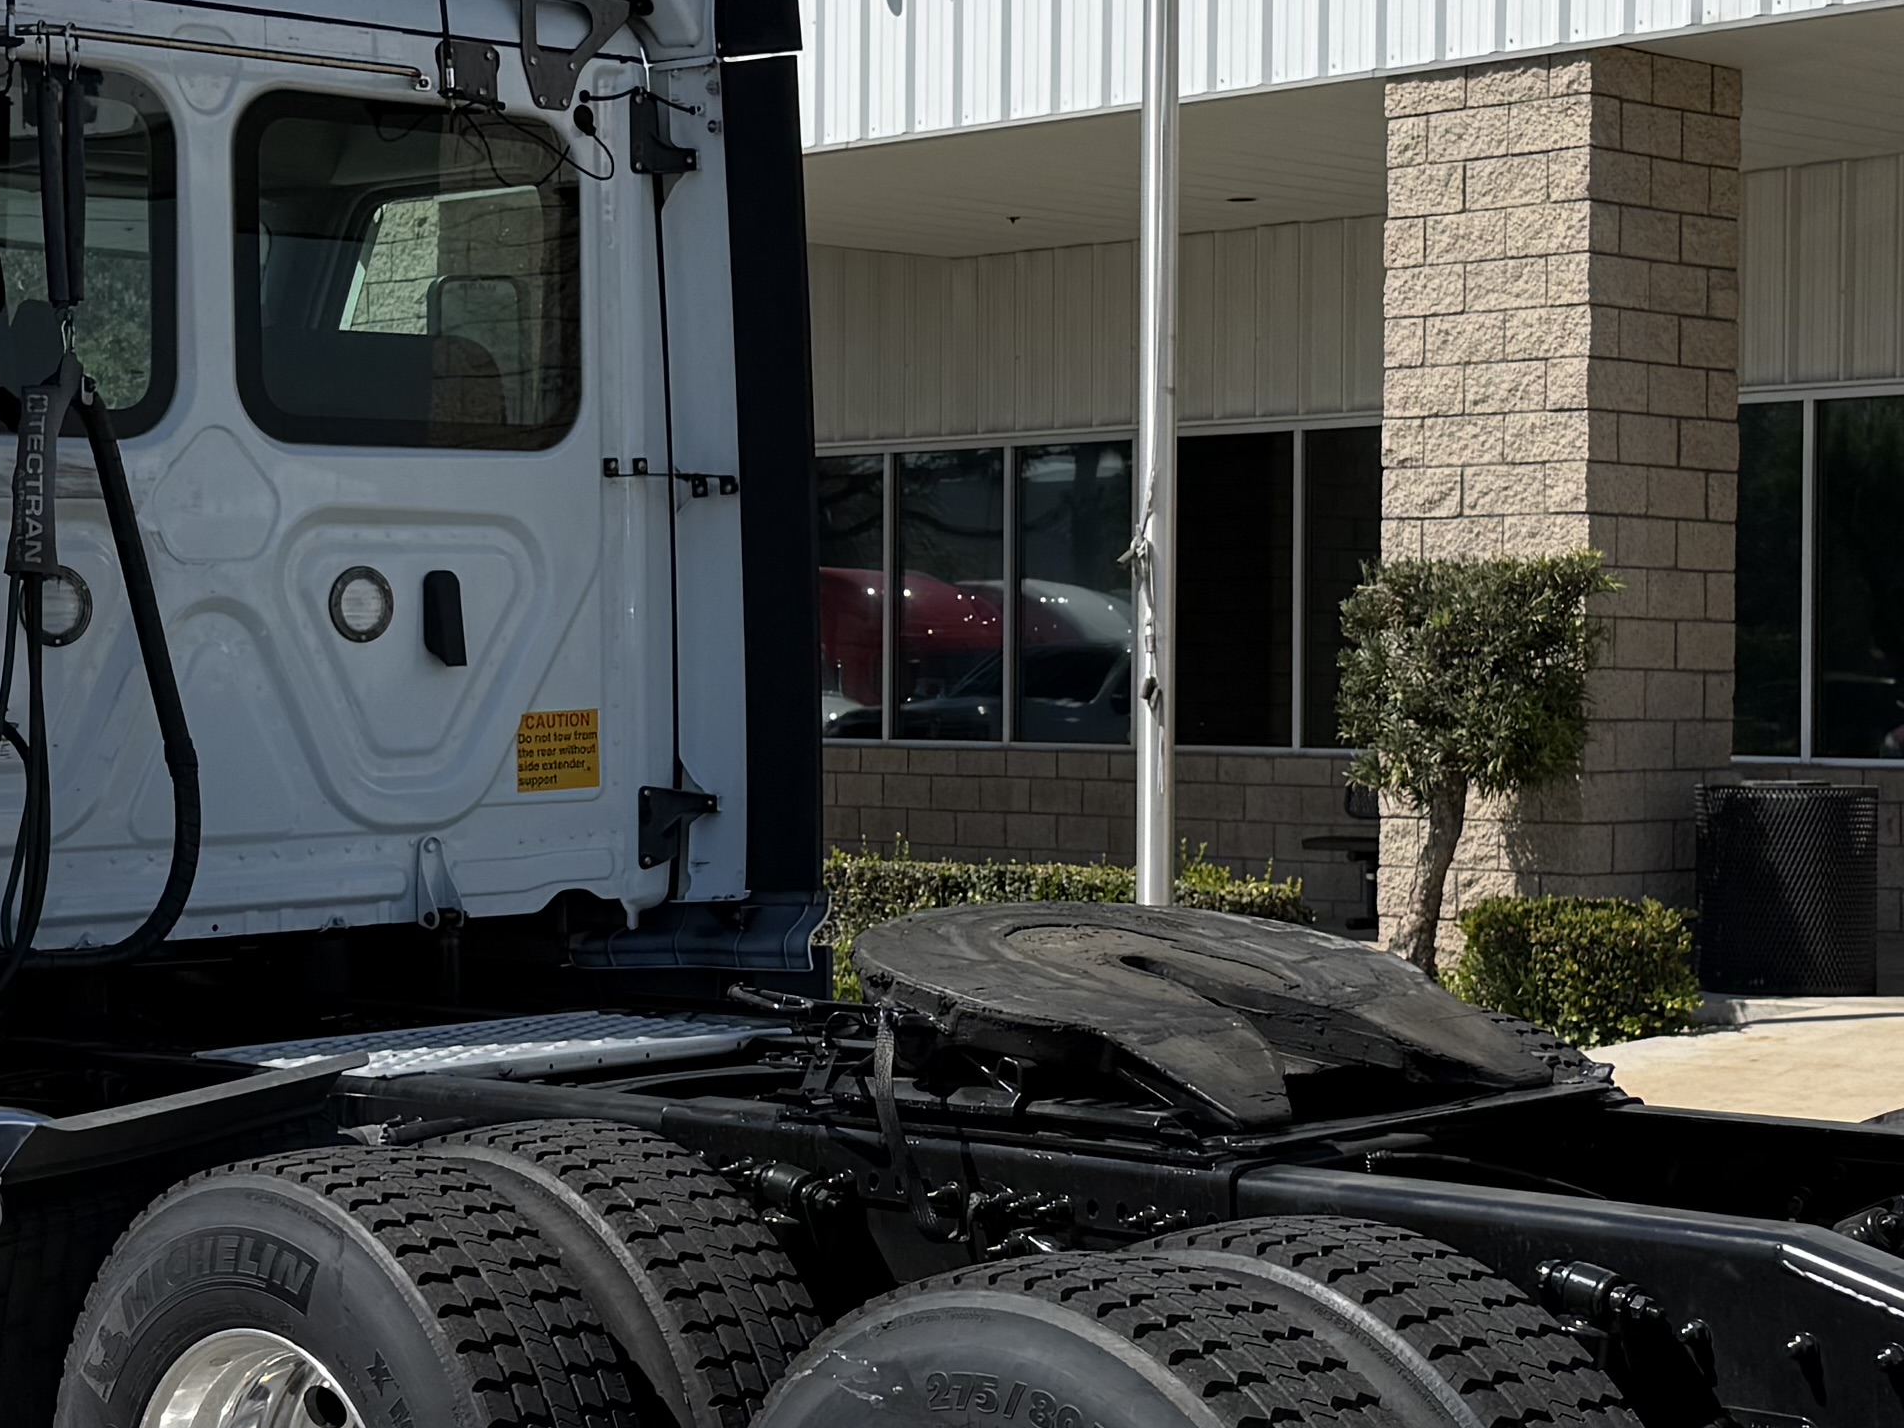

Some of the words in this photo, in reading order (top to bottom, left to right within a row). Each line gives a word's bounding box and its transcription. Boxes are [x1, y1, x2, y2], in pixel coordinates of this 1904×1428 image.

[25, 415, 45, 563] TECTRAN
[525, 713, 590, 729] CAUTION
[518, 734, 532, 744] Do
[535, 733, 551, 743] not
[554, 732, 572, 742] tow
[518, 748, 534, 758] the
[537, 747, 556, 756] rear
[559, 744, 595, 755] without
[518, 760, 539, 772] side
[518, 775, 558, 788] support
[121, 1234, 313, 1332] MICHELIN
